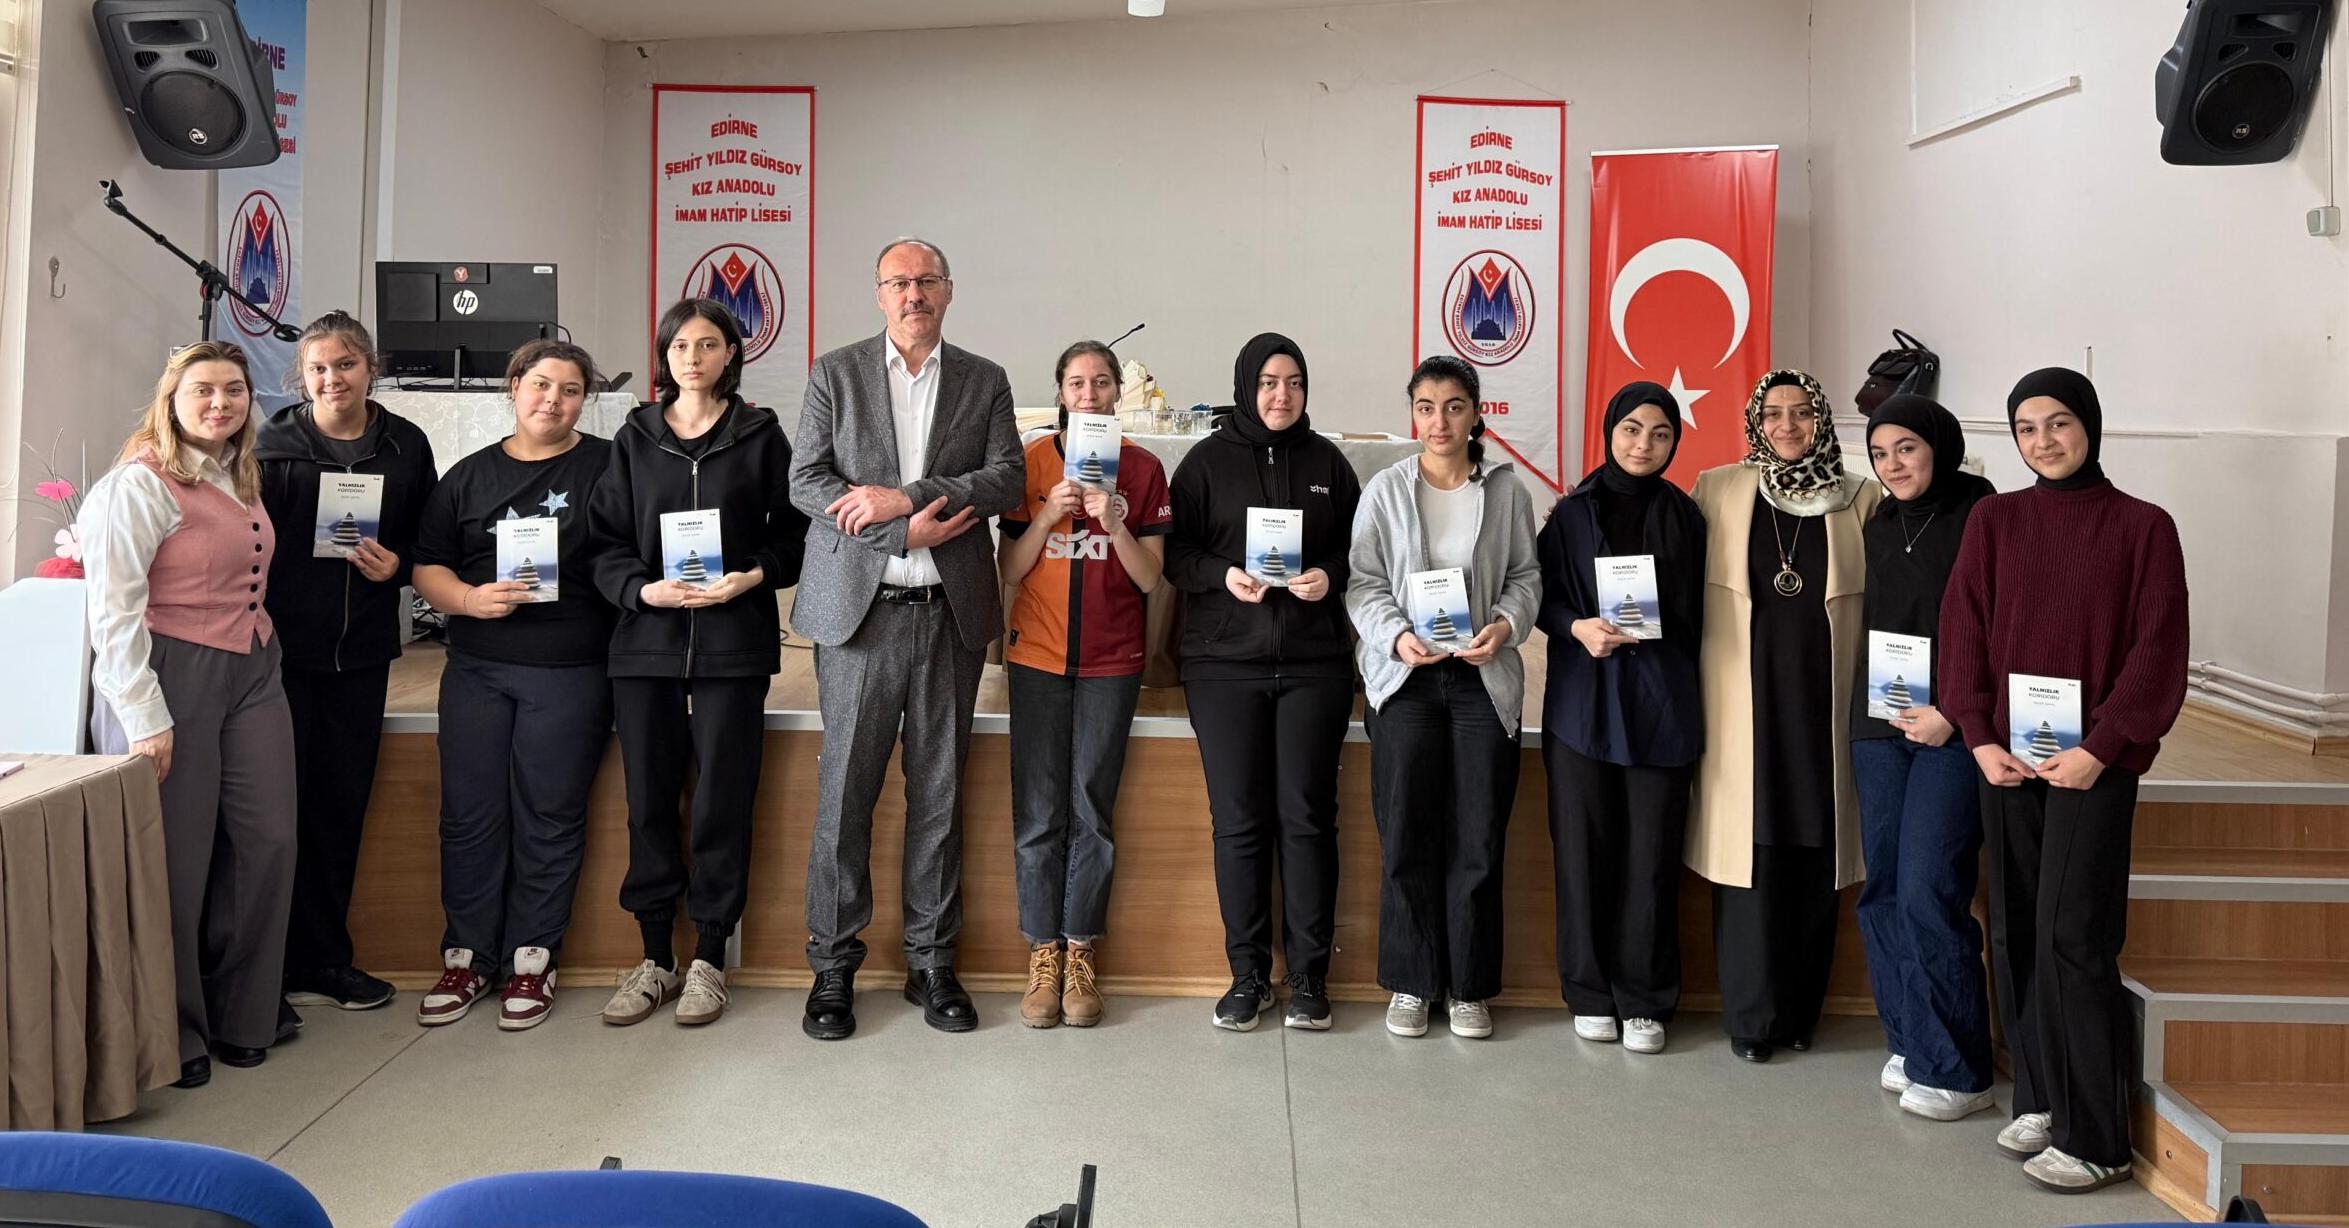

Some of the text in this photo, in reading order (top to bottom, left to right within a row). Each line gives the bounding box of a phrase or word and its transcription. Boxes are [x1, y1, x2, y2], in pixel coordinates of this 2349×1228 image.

[711, 113, 758, 138] EDİRNE
[1470, 126, 1512, 150] EDİRNE
[665, 148, 802, 180] ŞEHİT YILDIZ GÜRSOY
[1429, 160, 1552, 188] ŞEHİT YILDIZ GÜRSOY
[692, 179, 775, 196] KIZ ANADOLU
[1453, 187, 1528, 205] KIZ ANADOLU
[675, 201, 791, 222] İMAM HATİP LİSESİ
[1438, 209, 1542, 230] İMAM HATİP LİSESİ
[455, 290, 477, 314] hp
[1481, 402, 1509, 415] 016
